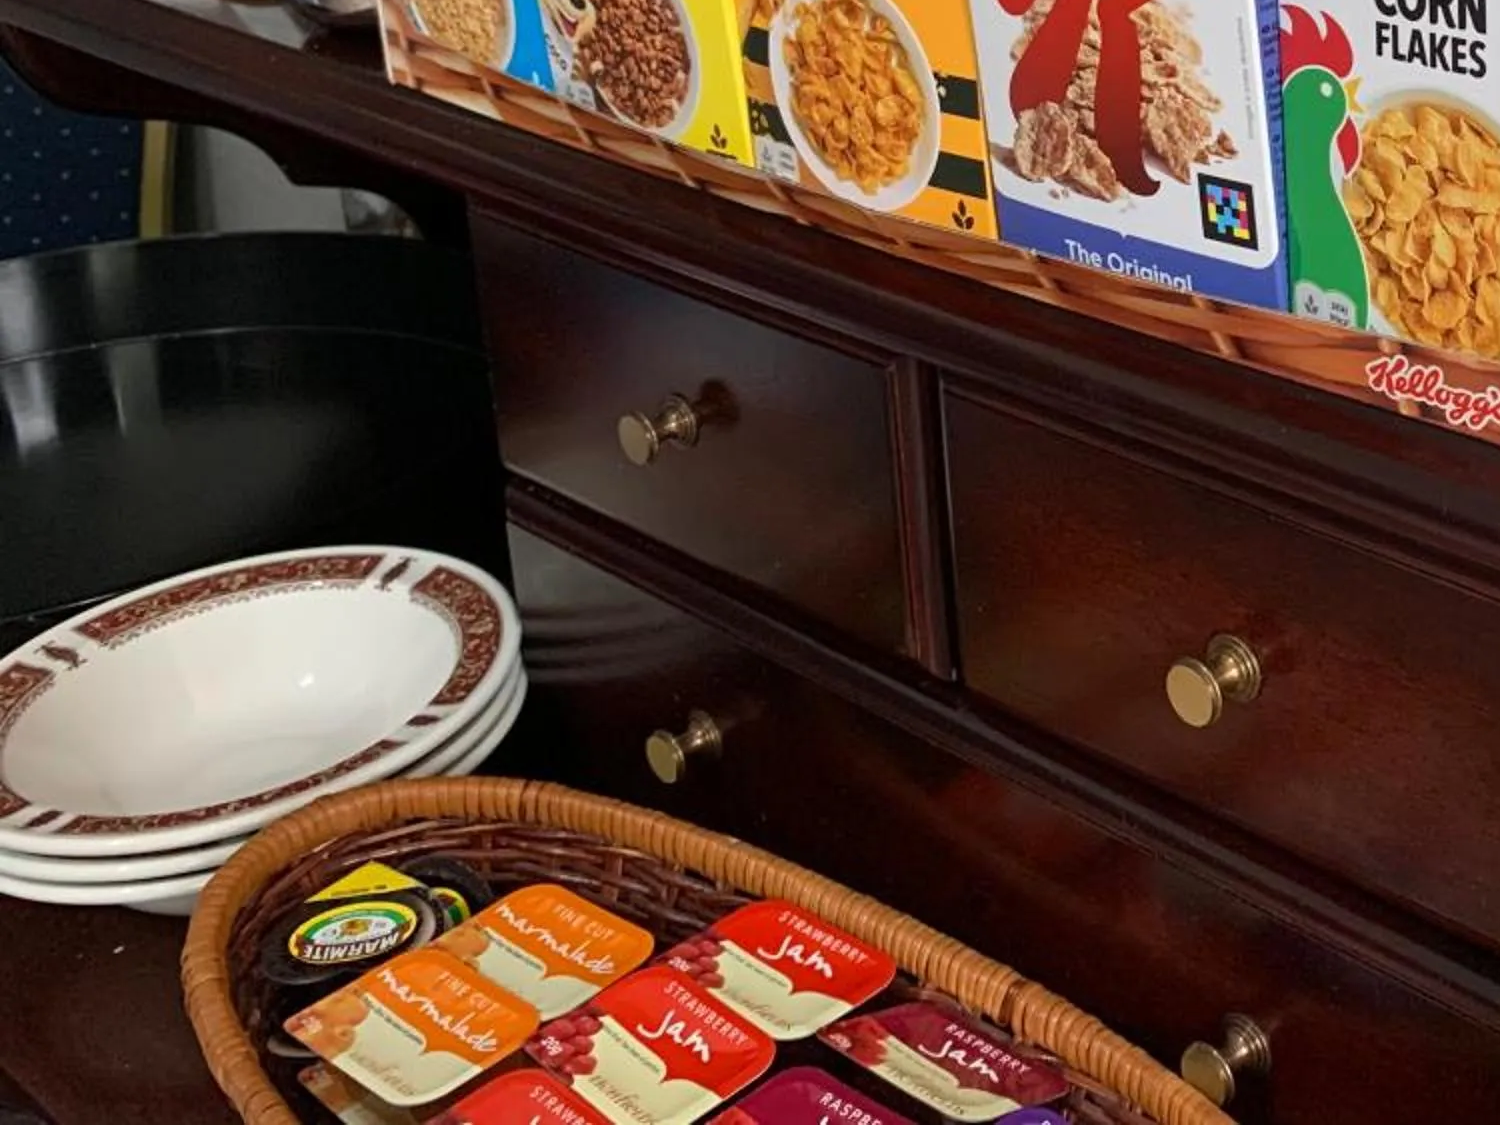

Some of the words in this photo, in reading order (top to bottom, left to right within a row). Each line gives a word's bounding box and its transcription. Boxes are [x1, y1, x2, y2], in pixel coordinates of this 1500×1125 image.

[1375, 21, 1487, 79] FLAKES
[1064, 238, 1103, 268] The
[303, 930, 400, 961] MARMITE
[496, 903, 615, 974] marmalade
[553, 903, 587, 929] FINE
[584, 919, 615, 940] CUT
[778, 910, 870, 965] STRAWBERRY
[756, 934, 833, 979] Jam
[377, 969, 497, 1052] marmalade
[636, 1008, 711, 1063] Jam
[664, 980, 750, 1047] STRAWBERRY
[917, 1040, 999, 1084] Jam
[945, 1024, 1032, 1074] RASPBERRY
